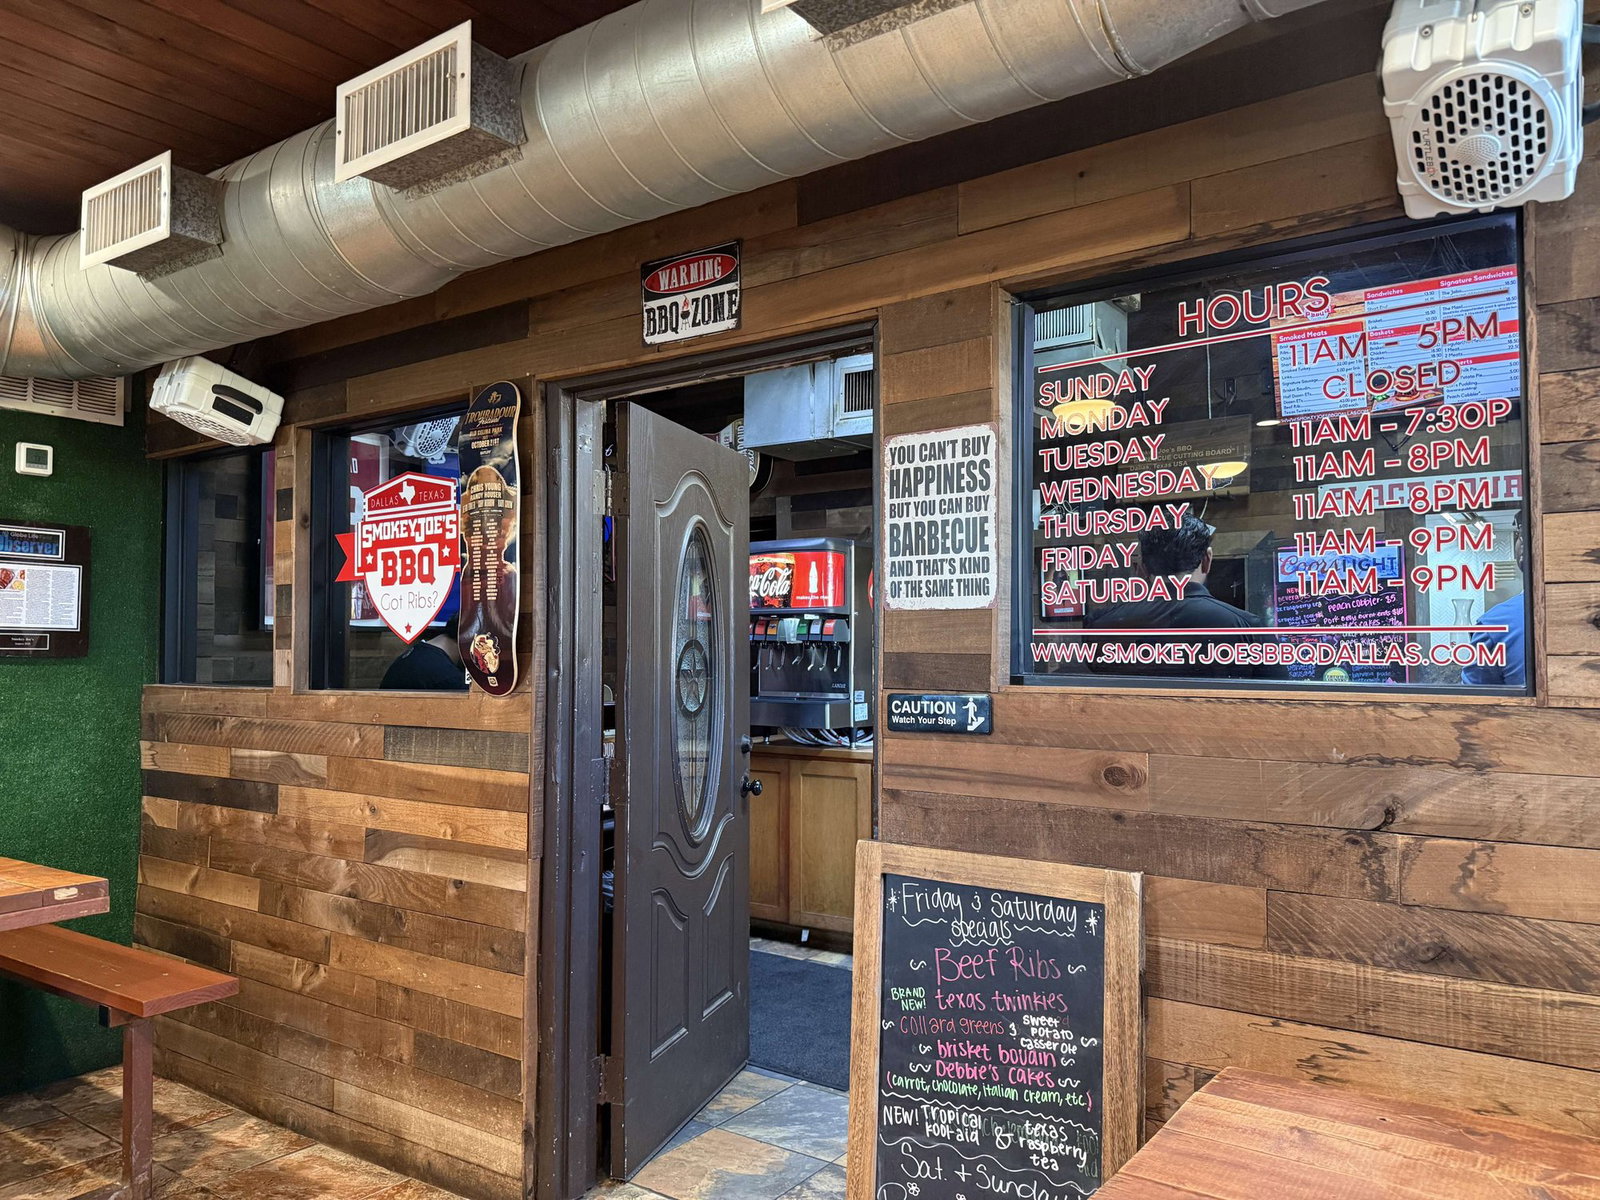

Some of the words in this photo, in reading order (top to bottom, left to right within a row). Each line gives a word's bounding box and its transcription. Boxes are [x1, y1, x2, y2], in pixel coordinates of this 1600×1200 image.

[658, 257, 721, 291] WARNING
[1440, 277, 1472, 287] Signature
[1473, 271, 1513, 281] Sandwiches
[1178, 276, 1332, 337] HOURS
[1366, 289, 1403, 298] Sandwiches
[645, 301, 679, 337] BBQ
[691, 290, 738, 327] ZONE
[1279, 334, 1305, 342] Smoked
[1306, 330, 1328, 338] Meats
[1039, 365, 1156, 408] SUNDAY
[1289, 331, 1368, 366] 11AM
[1418, 311, 1499, 349] 5PM
[1039, 398, 1170, 440] MONDAY
[1322, 360, 1461, 400] CLOSED
[471, 440, 490, 449] OCTOBER
[889, 445, 915, 466] YOU
[919, 439, 958, 463] CAN'T
[961, 435, 991, 458] BUY
[1039, 434, 1165, 474] TUESDAY
[1290, 413, 1371, 447] 11AM
[1173, 452, 1204, 460] CUTTING
[889, 459, 991, 500] HAPPINESS
[1040, 463, 1218, 506] WEDNESDAY
[1293, 447, 1374, 483] 11AM
[1407, 436, 1491, 473] 8PM
[370, 495, 399, 508] DALLAS
[418, 489, 445, 502] TEXAS
[889, 502, 911, 519] BUT
[913, 499, 936, 517] YOU
[939, 497, 962, 515] CAN
[965, 495, 990, 513] BUY
[1040, 503, 1189, 538] THURSDAY
[1293, 490, 1374, 522] 11AM
[1409, 480, 1492, 514] 8PM
[889, 516, 989, 558] BARBECUE
[1041, 542, 1138, 572] FRIDAY
[1294, 527, 1376, 558] 11AM
[1410, 524, 1494, 555] 9PM
[380, 547, 436, 587] BBQ
[889, 560, 913, 578] AND
[916, 557, 956, 577] THAT'S
[959, 556, 990, 574] KIND
[890, 580, 902, 599] OF
[904, 580, 923, 599] THE
[925, 579, 954, 598] SAME
[956, 577, 990, 597] THING
[1041, 575, 1192, 606] SATURDAY
[1296, 565, 1378, 596] 11AM
[1411, 563, 1496, 594] 9PM
[380, 592, 404, 611] Got
[407, 590, 439, 610] Ribs?
[1031, 642, 1506, 667] WWW.SMOKEYJOESBBQDALLAS.COM
[891, 700, 956, 714] CAUTION
[892, 715, 915, 724] Watch
[917, 716, 936, 724] Your
[938, 716, 957, 727] Step
[902, 883, 963, 925] Friday
[991, 893, 1077, 931] Saturday
[934, 947, 999, 985] Beef
[1006, 946, 1062, 980] Ribs
[890, 987, 926, 1000] BRAND
[992, 990, 1068, 1013] twinkies
[960, 1016, 1005, 1037] greens
[937, 1039, 992, 1060] brisket
[935, 1060, 999, 1080] Debbie's
[883, 1105, 919, 1125] NEW!
[921, 1104, 982, 1130] Tropical
[995, 1127, 1013, 1150] &
[1024, 1120, 1068, 1140] texas
[901, 1142, 948, 1181] Sat.
[1020, 1137, 1087, 1168] raspberry
[1030, 1154, 1060, 1171] tea
